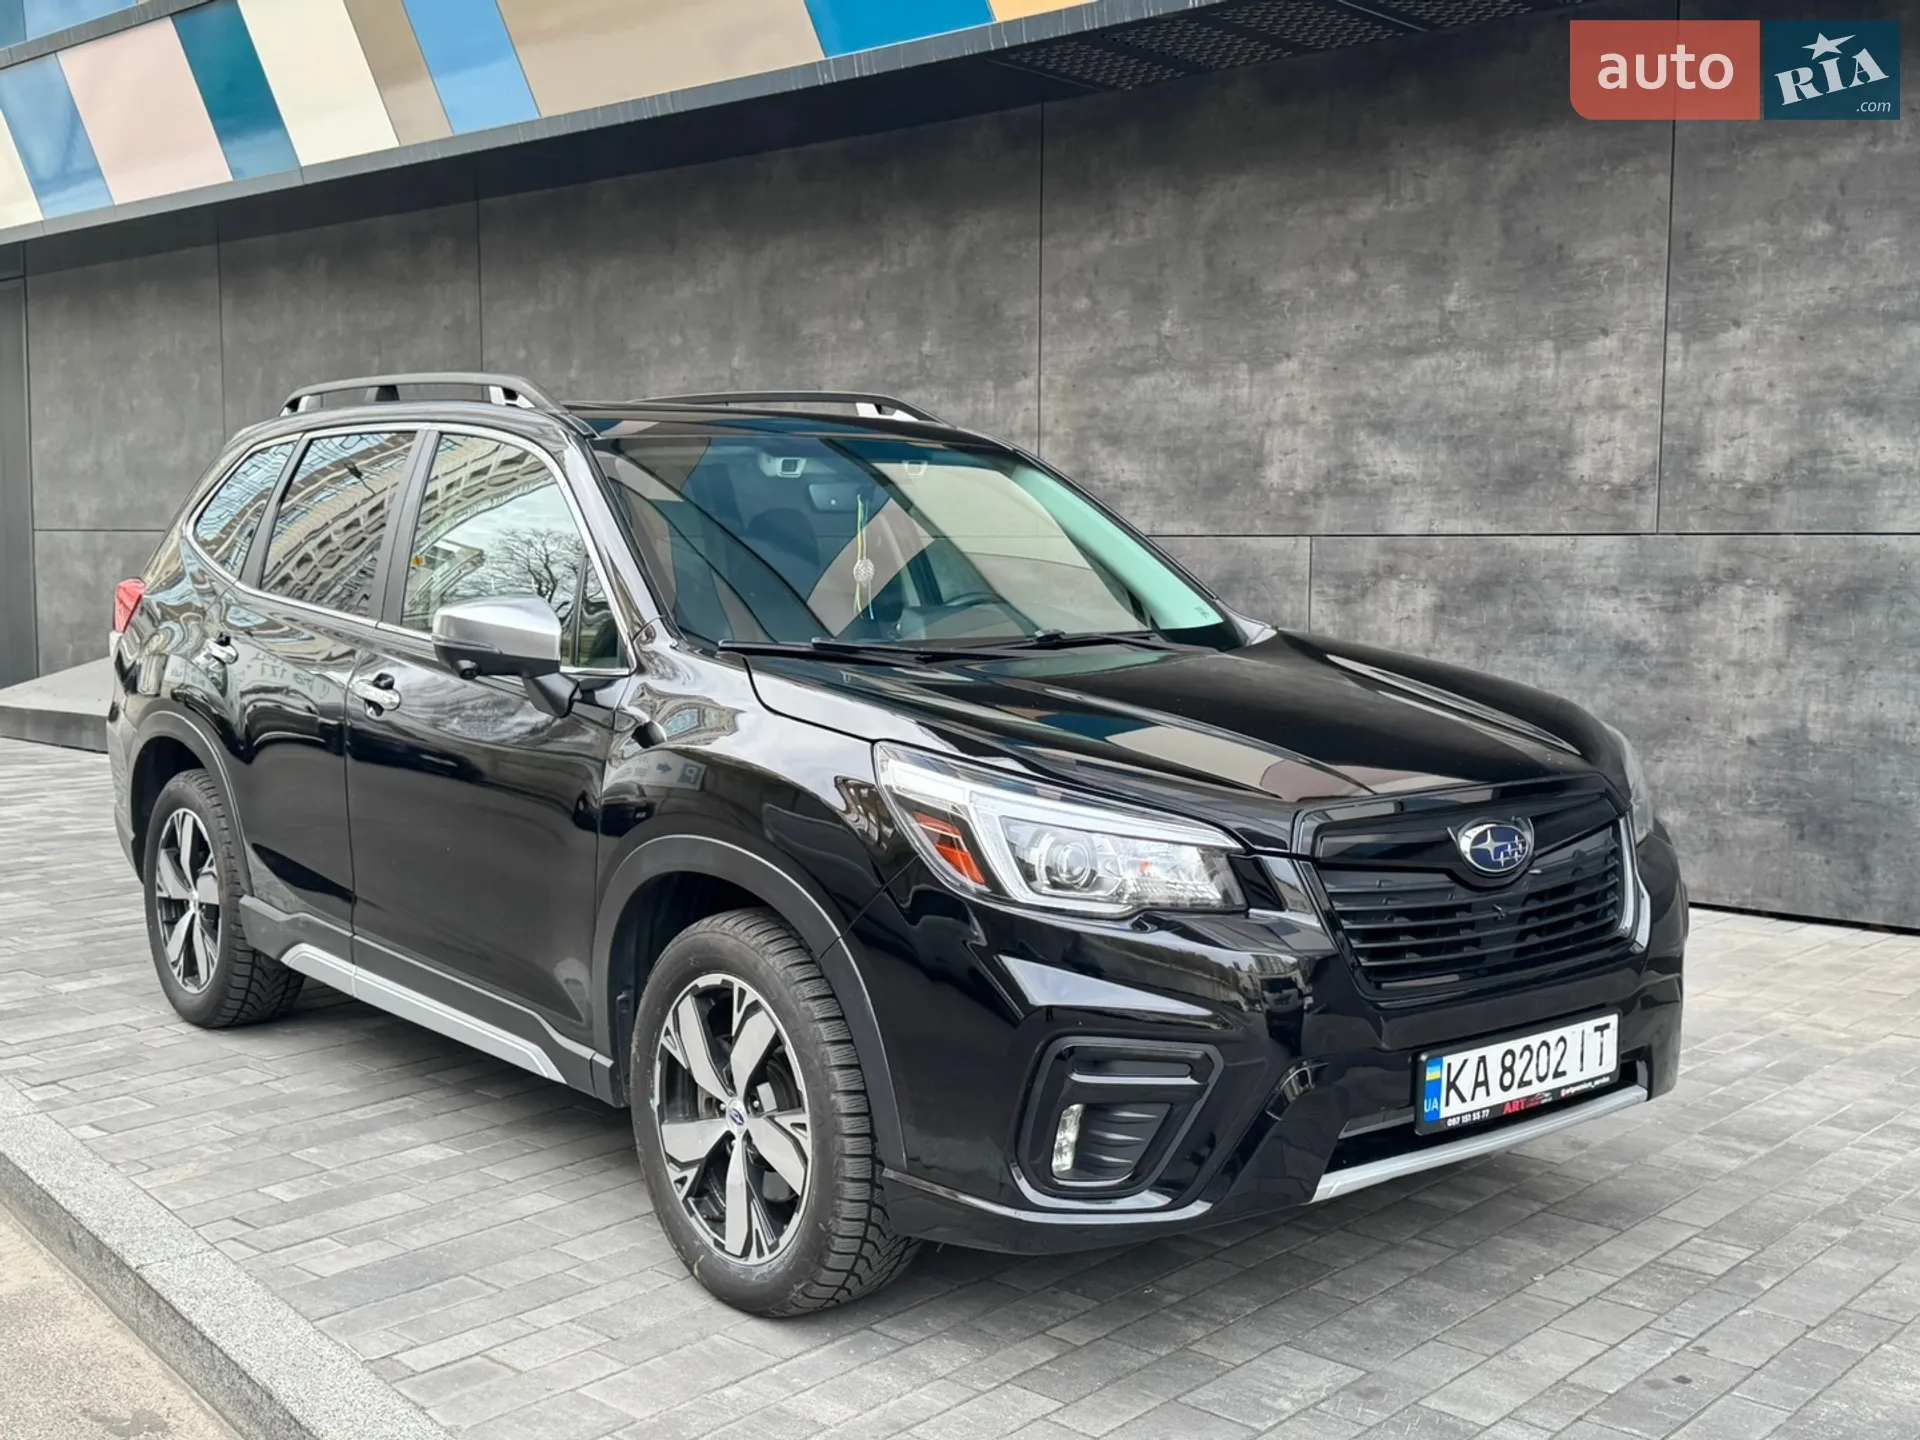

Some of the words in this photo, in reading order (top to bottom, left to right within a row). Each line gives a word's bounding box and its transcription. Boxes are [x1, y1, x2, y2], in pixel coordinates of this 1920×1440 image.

[1444, 1055, 1490, 1107] KA
[1499, 1035, 1567, 1092] 8202
[1579, 1022, 1611, 1072] IT
[1423, 1096, 1439, 1113] UA
[1481, 1108, 1490, 1118] 77
[1503, 1098, 1527, 1115] ART
